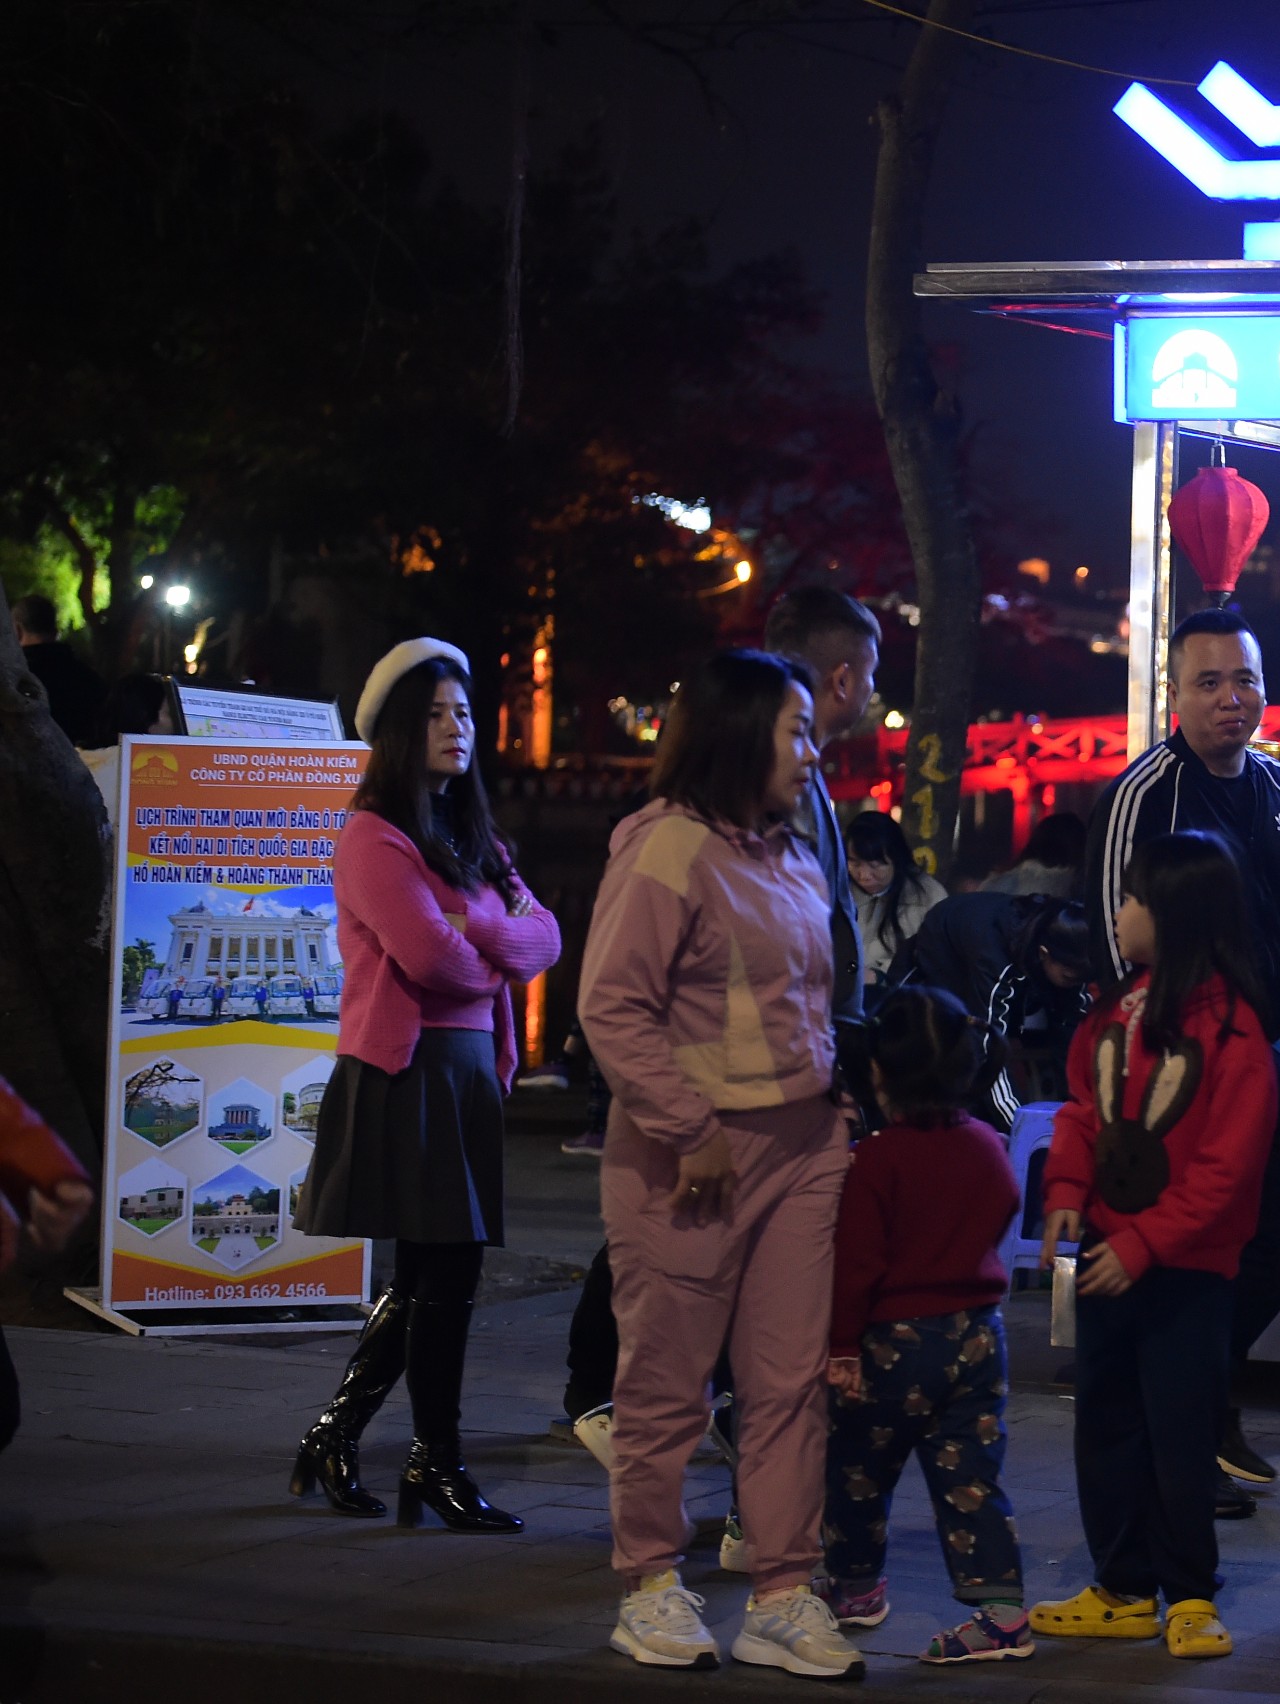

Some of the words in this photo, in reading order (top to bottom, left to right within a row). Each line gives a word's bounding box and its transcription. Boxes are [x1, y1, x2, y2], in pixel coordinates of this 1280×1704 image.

[214, 754, 247, 765] UBND
[251, 753, 285, 768] QUẬN
[288, 753, 323, 768] HOÀN
[326, 753, 357, 768] KIẾM
[190, 768, 225, 781] CÔNG
[230, 770, 245, 781] TY
[248, 769, 265, 782] CỔ
[268, 769, 302, 782] PHẦN
[306, 770, 340, 783] ĐỒNG
[343, 773, 363, 784] XU
[136, 808, 161, 829] LỊCH
[164, 805, 196, 826] TRÌNH
[200, 809, 230, 827] THAM
[234, 810, 263, 830] QUAN
[266, 807, 287, 829] MỚI
[290, 805, 320, 829] BẰNG
[322, 809, 330, 829] Ô
[333, 808, 345, 830] TÔ
[149, 832, 170, 855] KẾT
[173, 831, 192, 855] NỐI
[194, 838, 215, 855] HAI
[217, 838, 227, 856] DI
[231, 835, 254, 856] TÍCH
[258, 834, 287, 858] QUỐC
[291, 839, 308, 857] GIA
[311, 836, 334, 862] ĐẶC
[134, 860, 148, 883] HỒ
[151, 862, 181, 883] HOÀN
[184, 861, 212, 883] KIẾM
[216, 868, 224, 883] &
[227, 865, 265, 884] HOÀNG
[268, 865, 303, 885] THÀNH
[145, 1286, 209, 1301] Hotline:
[214, 1284, 244, 1300] 093
[250, 1283, 281, 1298] 662
[285, 1282, 326, 1298] 4566
